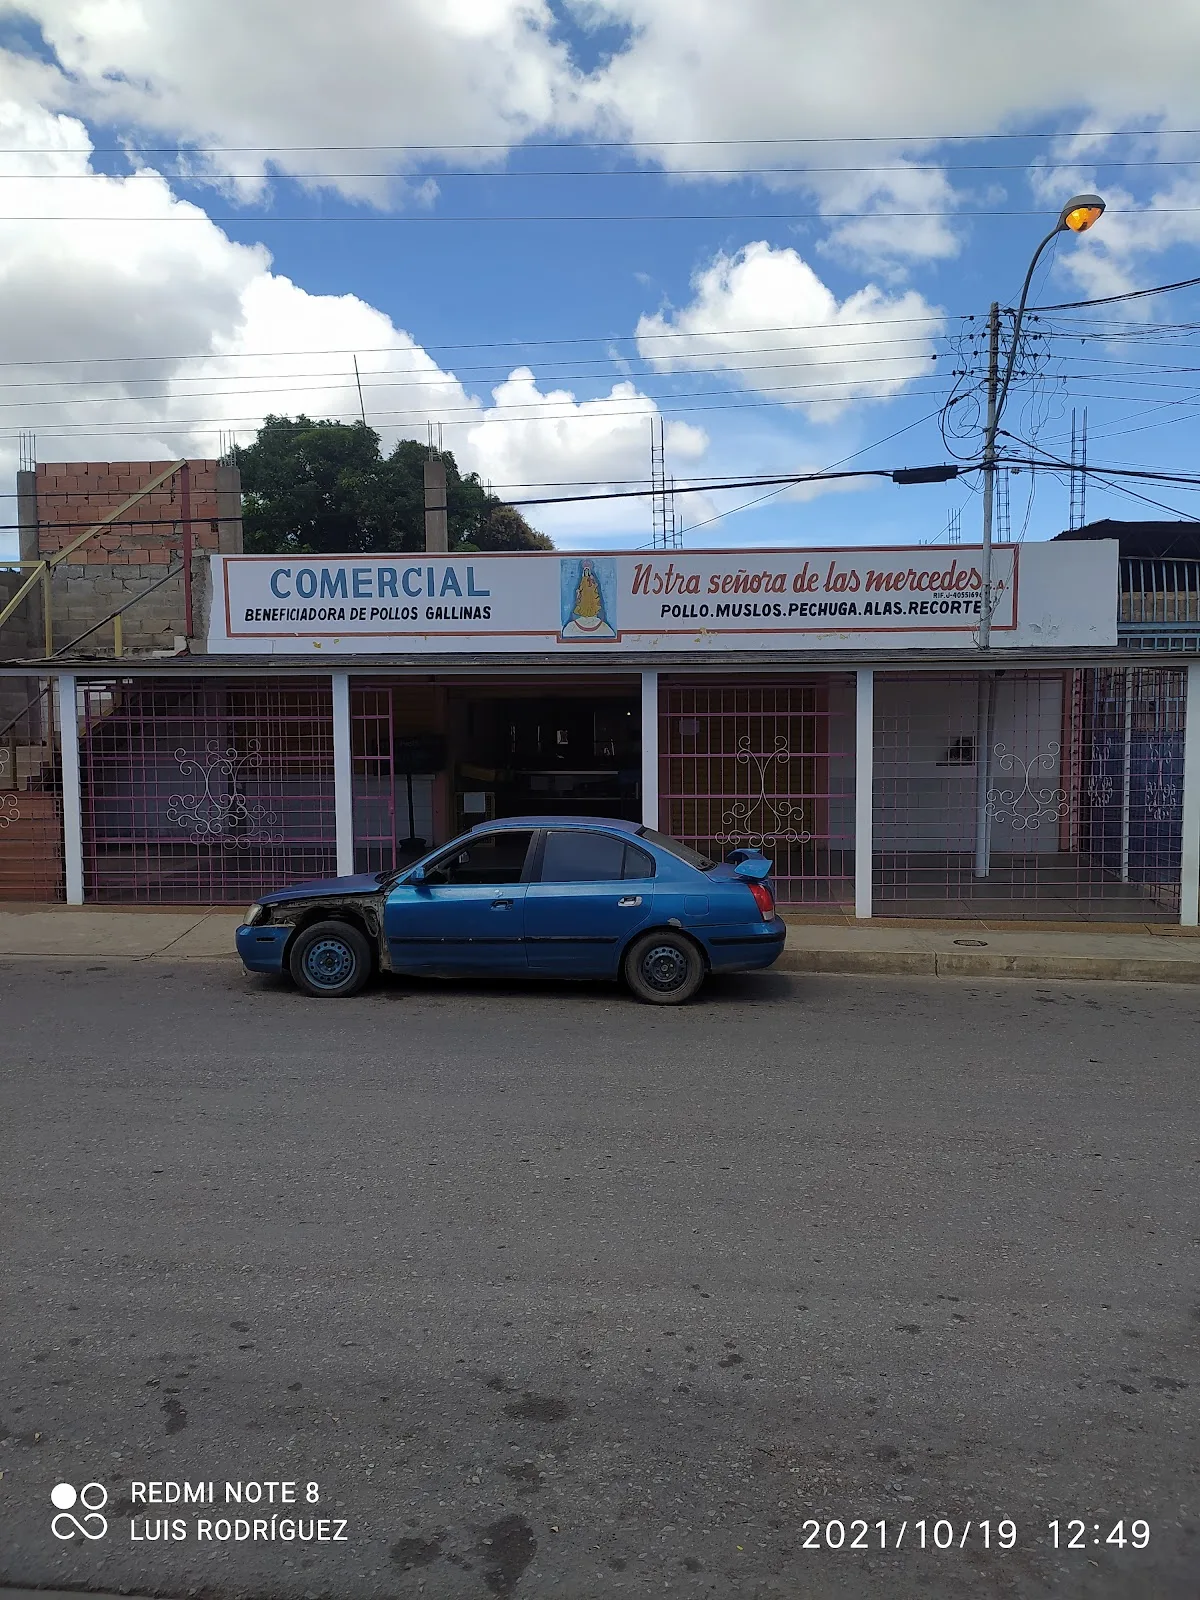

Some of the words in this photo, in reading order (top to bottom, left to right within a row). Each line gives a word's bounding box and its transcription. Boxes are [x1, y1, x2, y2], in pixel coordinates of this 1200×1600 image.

[269, 566, 491, 599] COMERCIAL
[707, 569, 788, 594] señora
[792, 561, 819, 593] de
[823, 560, 861, 593] las
[864, 559, 983, 592] mercedes
[244, 607, 346, 622] BENEFICIADORA
[349, 607, 367, 621] DE
[370, 606, 419, 621] POLLOS
[425, 605, 492, 620] GALLINAS
